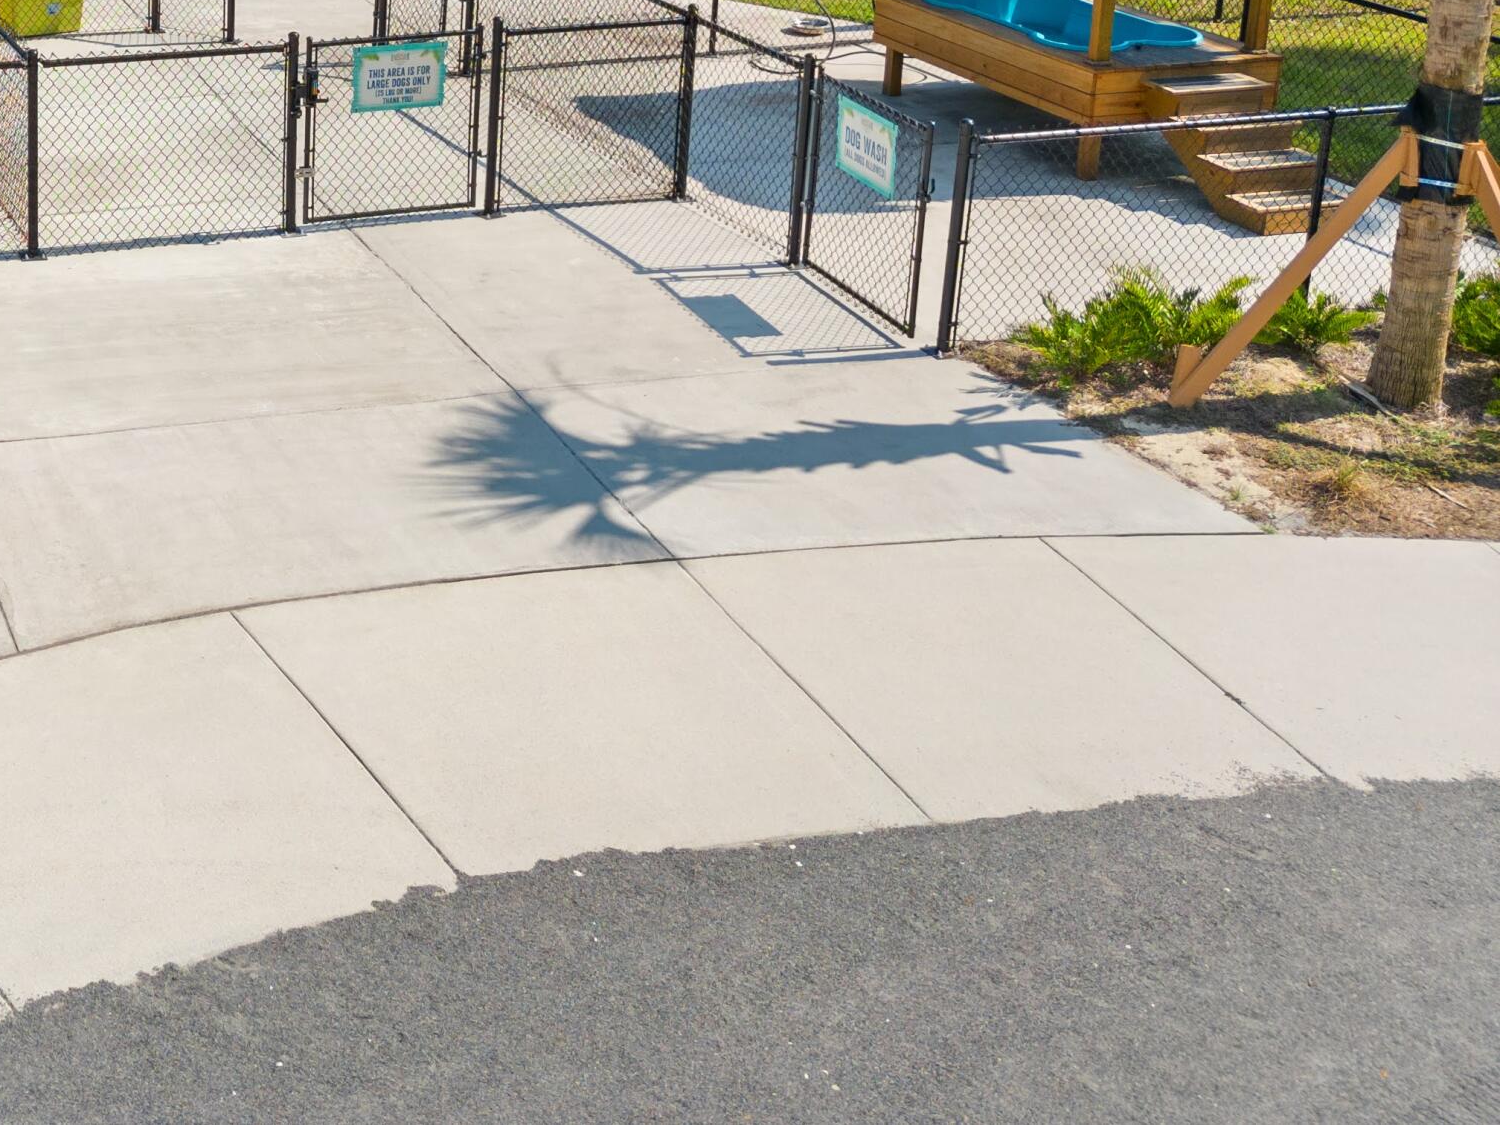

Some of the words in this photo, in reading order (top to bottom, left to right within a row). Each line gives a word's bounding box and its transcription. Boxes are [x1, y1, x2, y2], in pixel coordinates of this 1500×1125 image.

[368, 69, 385, 78] THIS
[387, 67, 405, 77] AREA
[408, 67, 415, 76] IS
[417, 65, 431, 75] FOR
[367, 80, 390, 90] LARGE
[392, 78, 411, 88] DOGS
[413, 76, 431, 86] ONLY
[385, 88, 395, 96] LBS
[382, 96, 400, 104] THANK
[845, 126, 861, 149] DOG
[863, 135, 887, 166] WASH
[854, 153, 865, 167] DOGS
